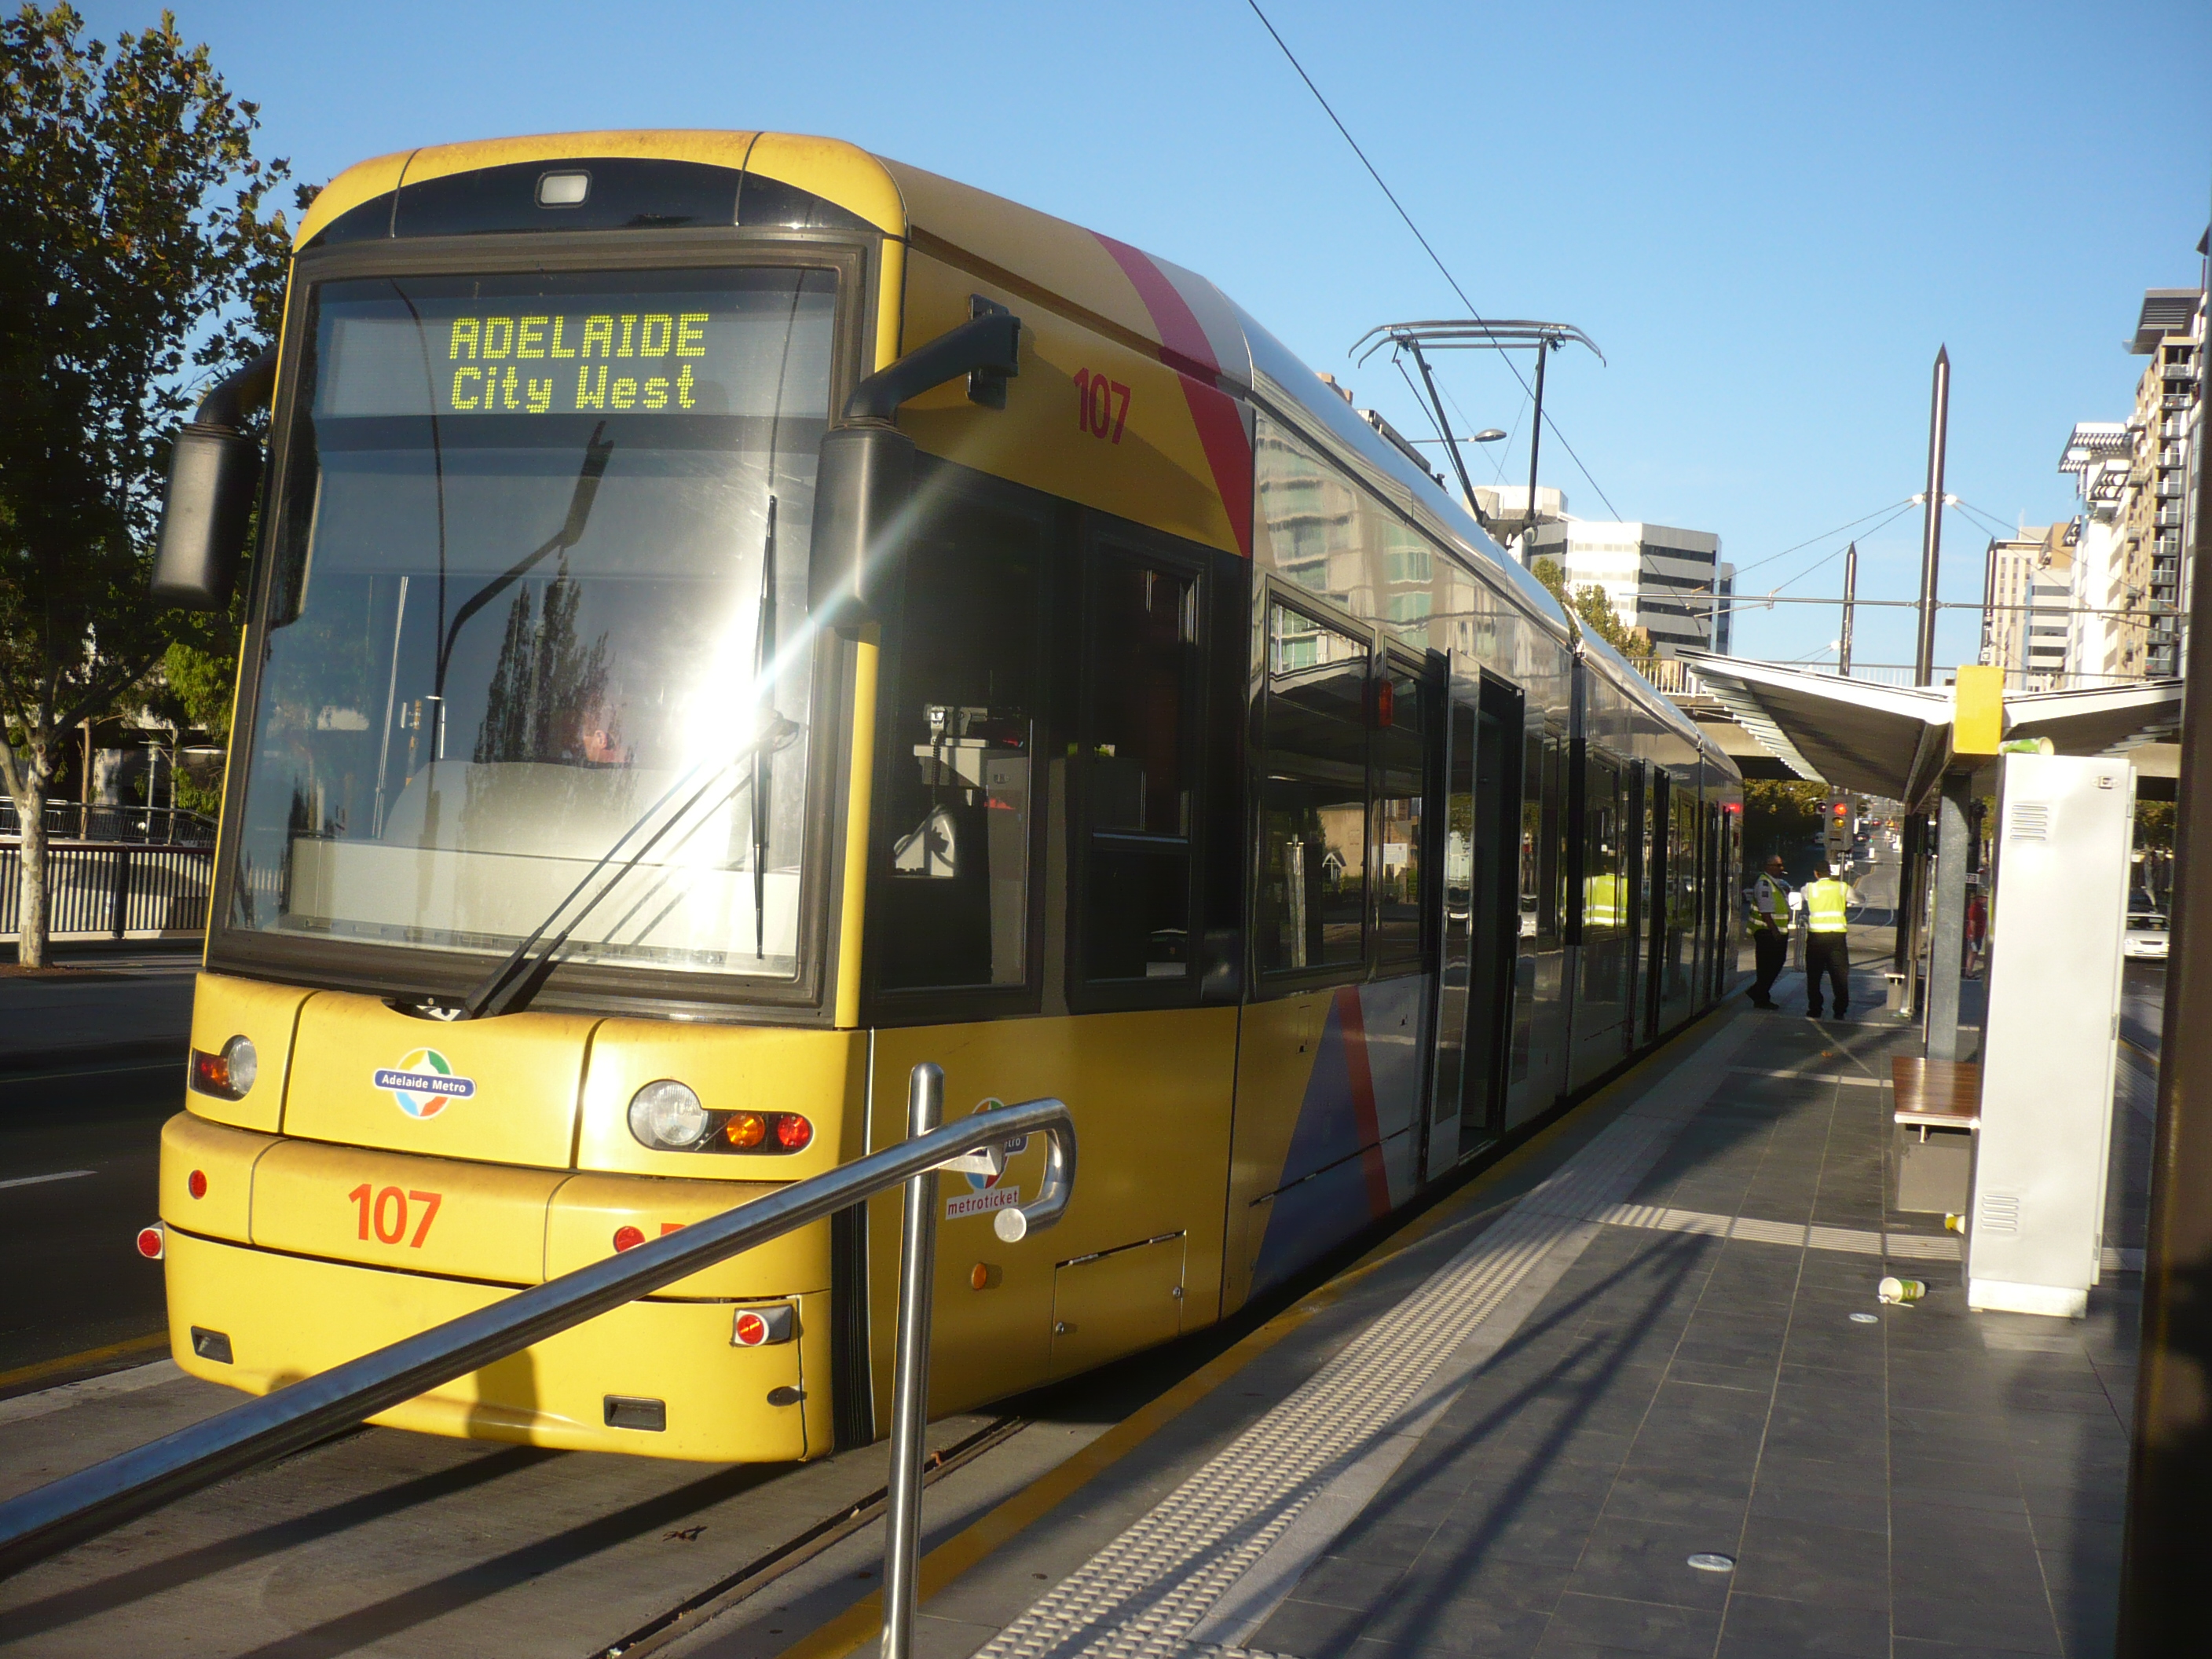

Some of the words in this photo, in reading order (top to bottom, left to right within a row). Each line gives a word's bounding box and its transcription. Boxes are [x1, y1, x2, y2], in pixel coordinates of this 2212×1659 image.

[449, 313, 709, 360] ADELAIDE
[451, 365, 553, 414] City
[575, 364, 696, 409] West
[1073, 367, 1131, 445] 107
[382, 1074, 429, 1089] Adelaide
[432, 1079, 466, 1093] Metro
[348, 1183, 442, 1249] 107
[948, 1190, 1018, 1215] metroticket
